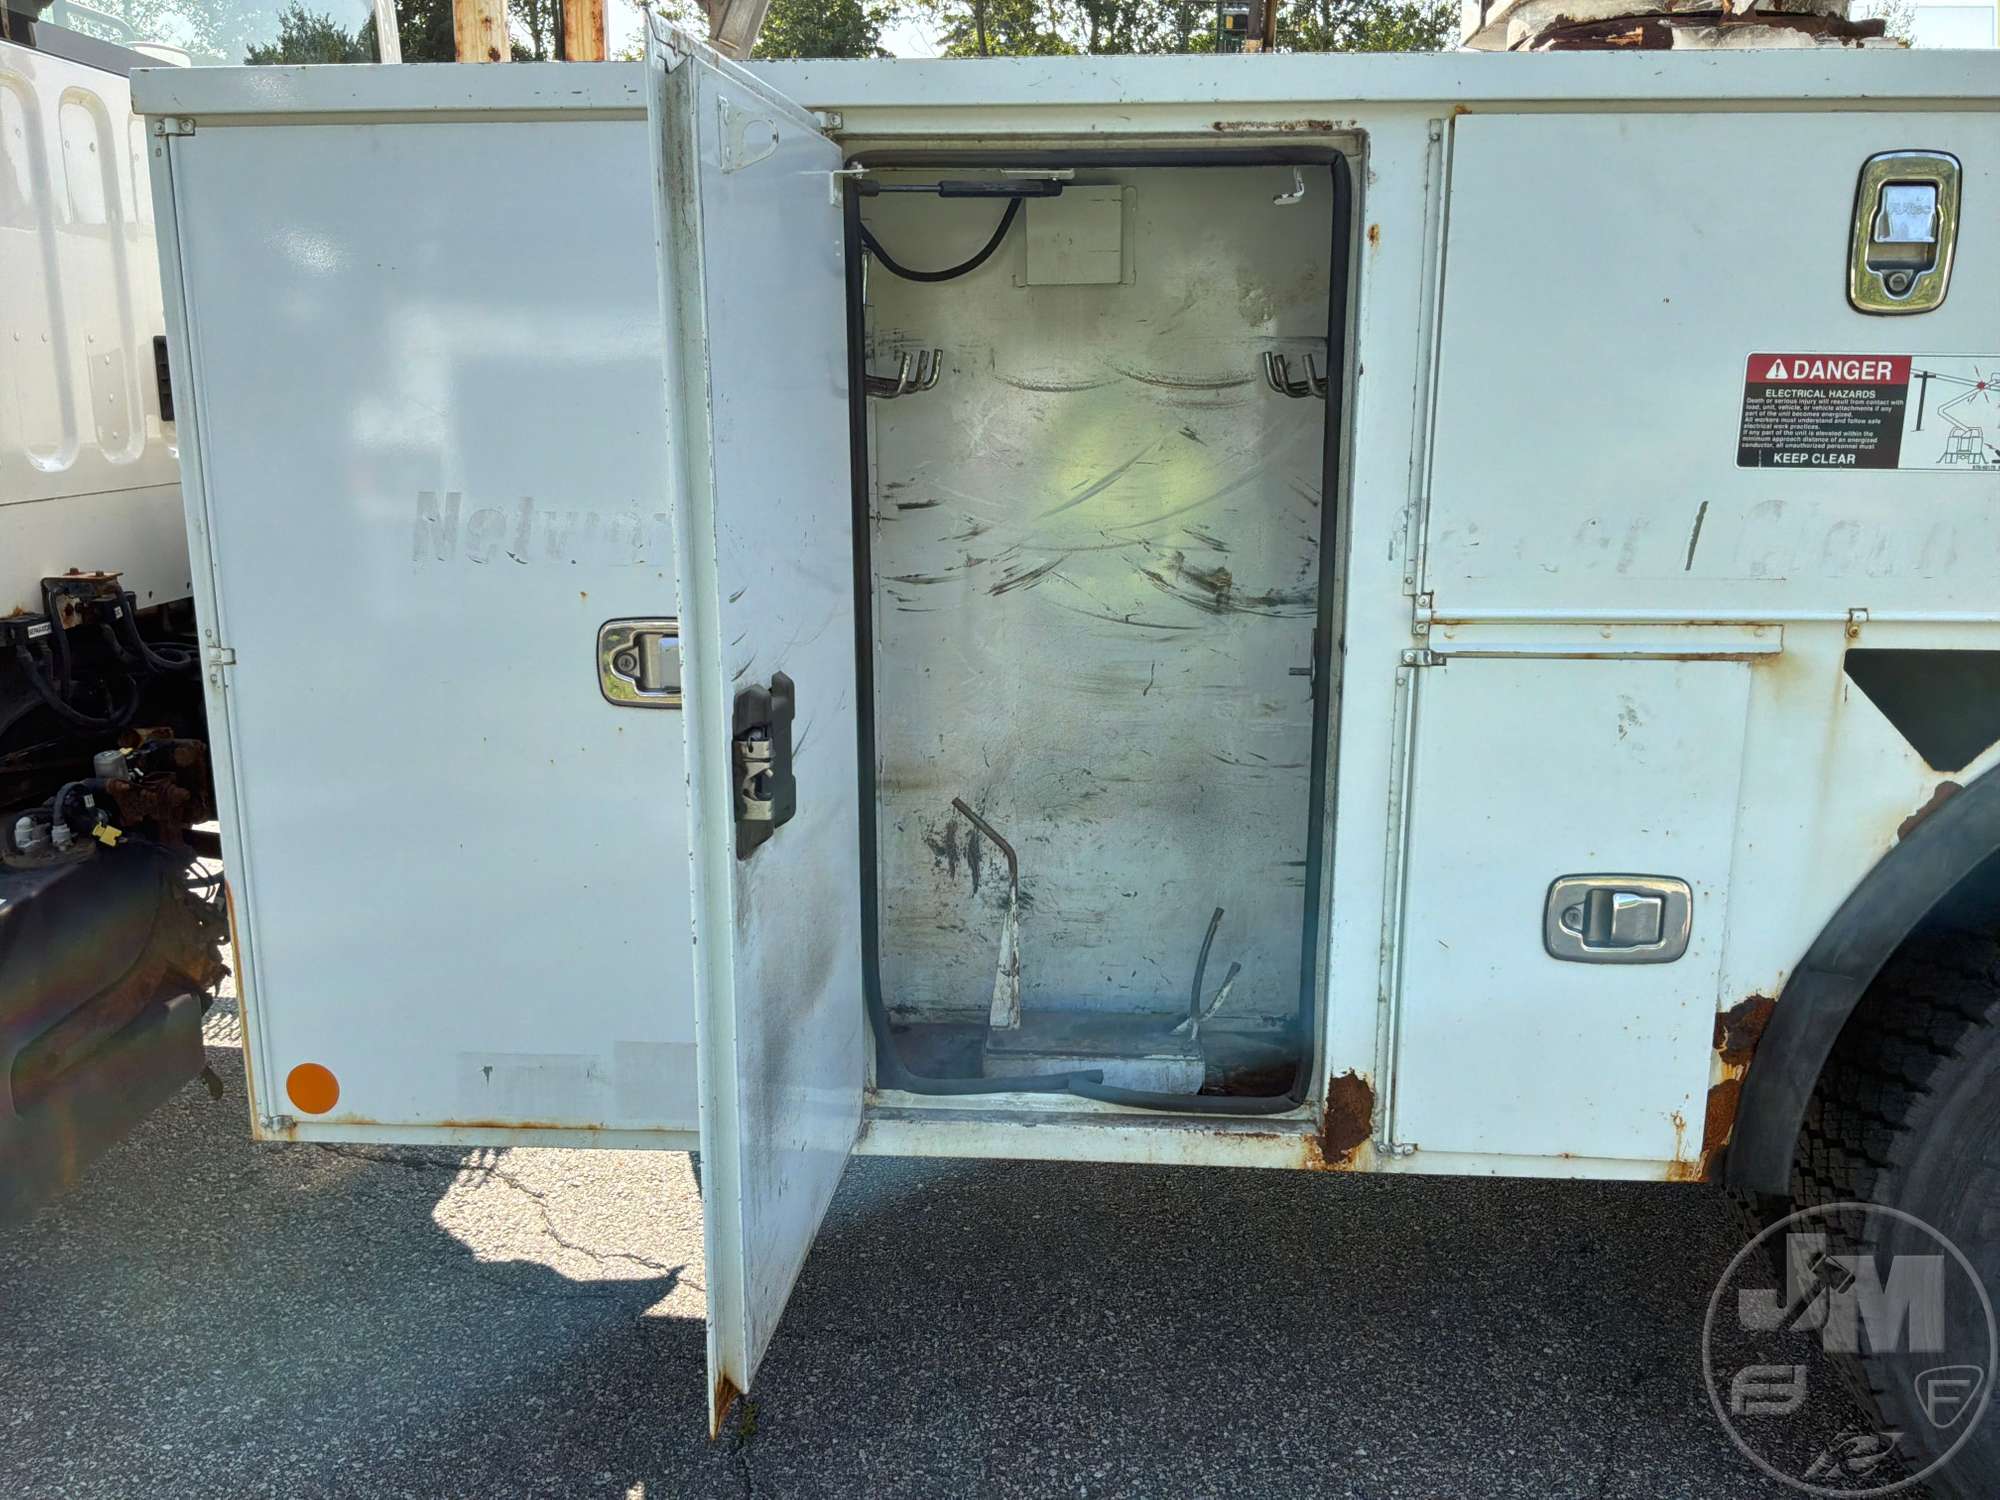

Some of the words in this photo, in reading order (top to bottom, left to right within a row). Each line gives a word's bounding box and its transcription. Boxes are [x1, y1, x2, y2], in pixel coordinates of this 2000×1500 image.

[1794, 360, 1892, 380] DANGER
[1766, 389, 1826, 398] ELECTRICAL
[1828, 390, 1876, 399] HAZARDS
[1774, 453, 1808, 463] KEEP
[1812, 453, 1856, 464] CLEAR
